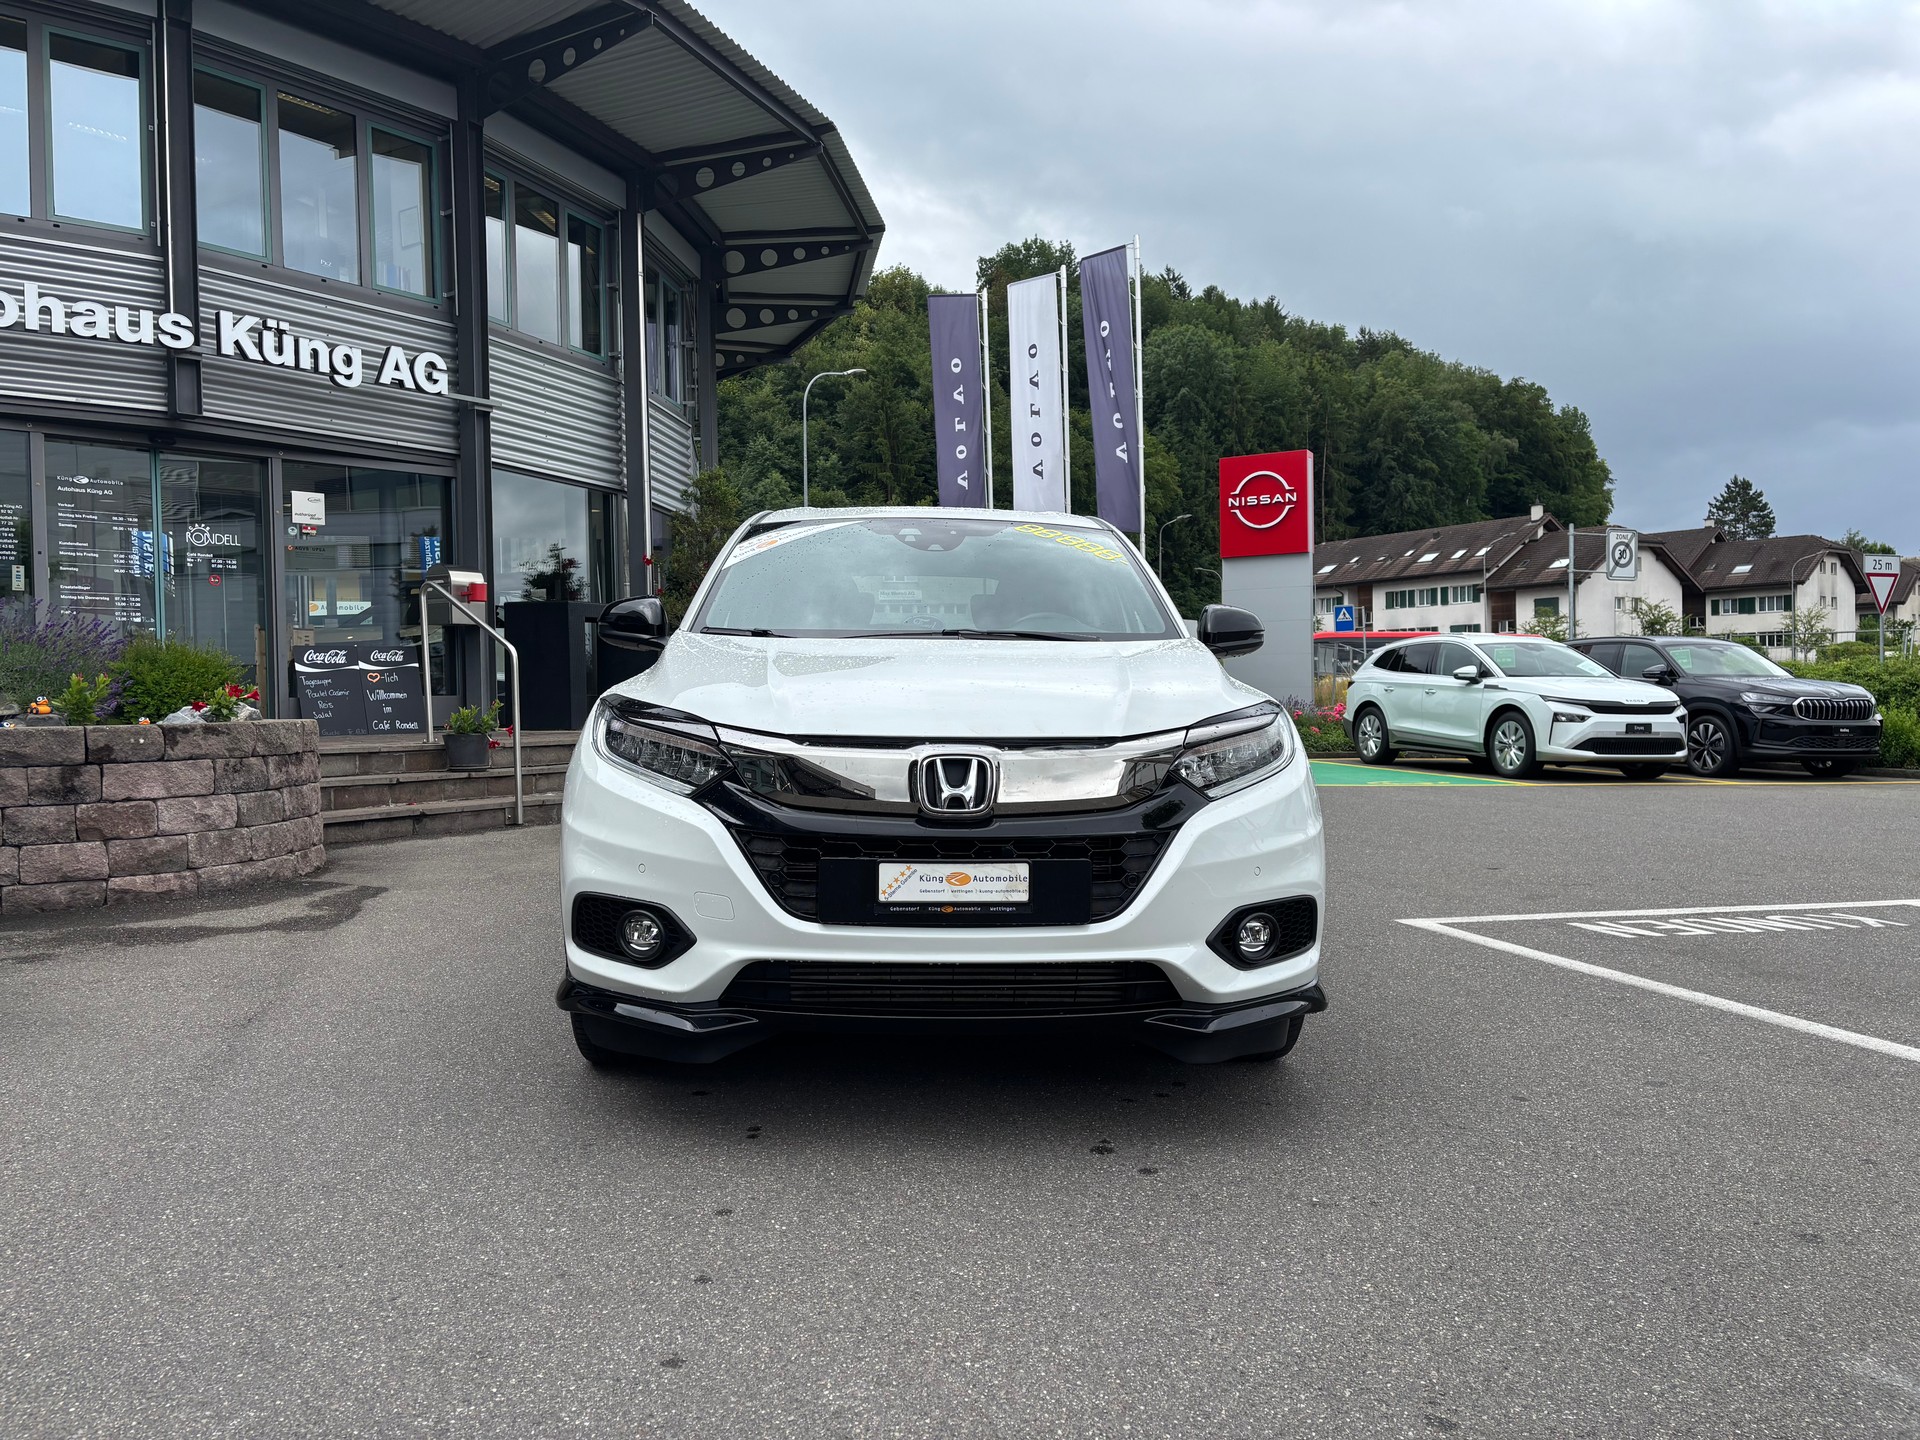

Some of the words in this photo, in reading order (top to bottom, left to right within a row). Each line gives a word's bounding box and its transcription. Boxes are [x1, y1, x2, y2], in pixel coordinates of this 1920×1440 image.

[216, 310, 363, 388] Küng
[377, 345, 449, 395] AG
[1228, 492, 1297, 508] NISSAN
[1618, 549, 1627, 560] 30
[1873, 560, 1882, 570] 25
[1885, 562, 1892, 570] m
[304, 650, 347, 664] Coca-Cola
[370, 650, 404, 662] Coca-Cola
[367, 689, 407, 701] Willkommen
[382, 704, 392, 713] im
[372, 720, 390, 730] Café
[396, 720, 419, 729] Rondell
[919, 874, 944, 884] Küng
[973, 874, 1028, 882] Automobile
